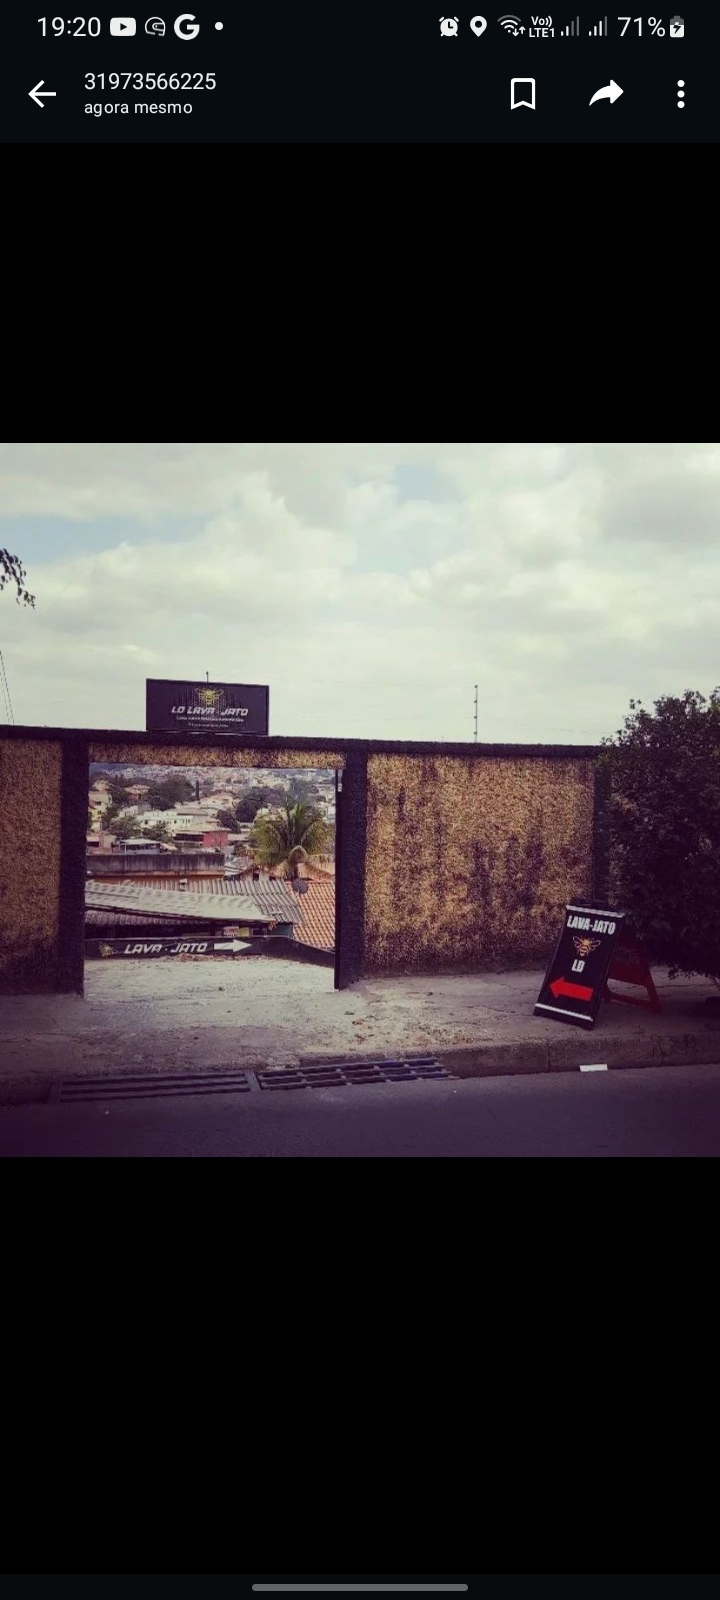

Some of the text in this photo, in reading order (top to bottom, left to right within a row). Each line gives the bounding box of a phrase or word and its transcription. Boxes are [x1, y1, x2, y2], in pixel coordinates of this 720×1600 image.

[187, 706, 215, 715] LAVA
[220, 707, 249, 717] JATO
[566, 915, 617, 935] LAVA-JATO
[124, 943, 163, 954] LAVA
[170, 942, 208, 953] JATO
[571, 959, 586, 973] LD
